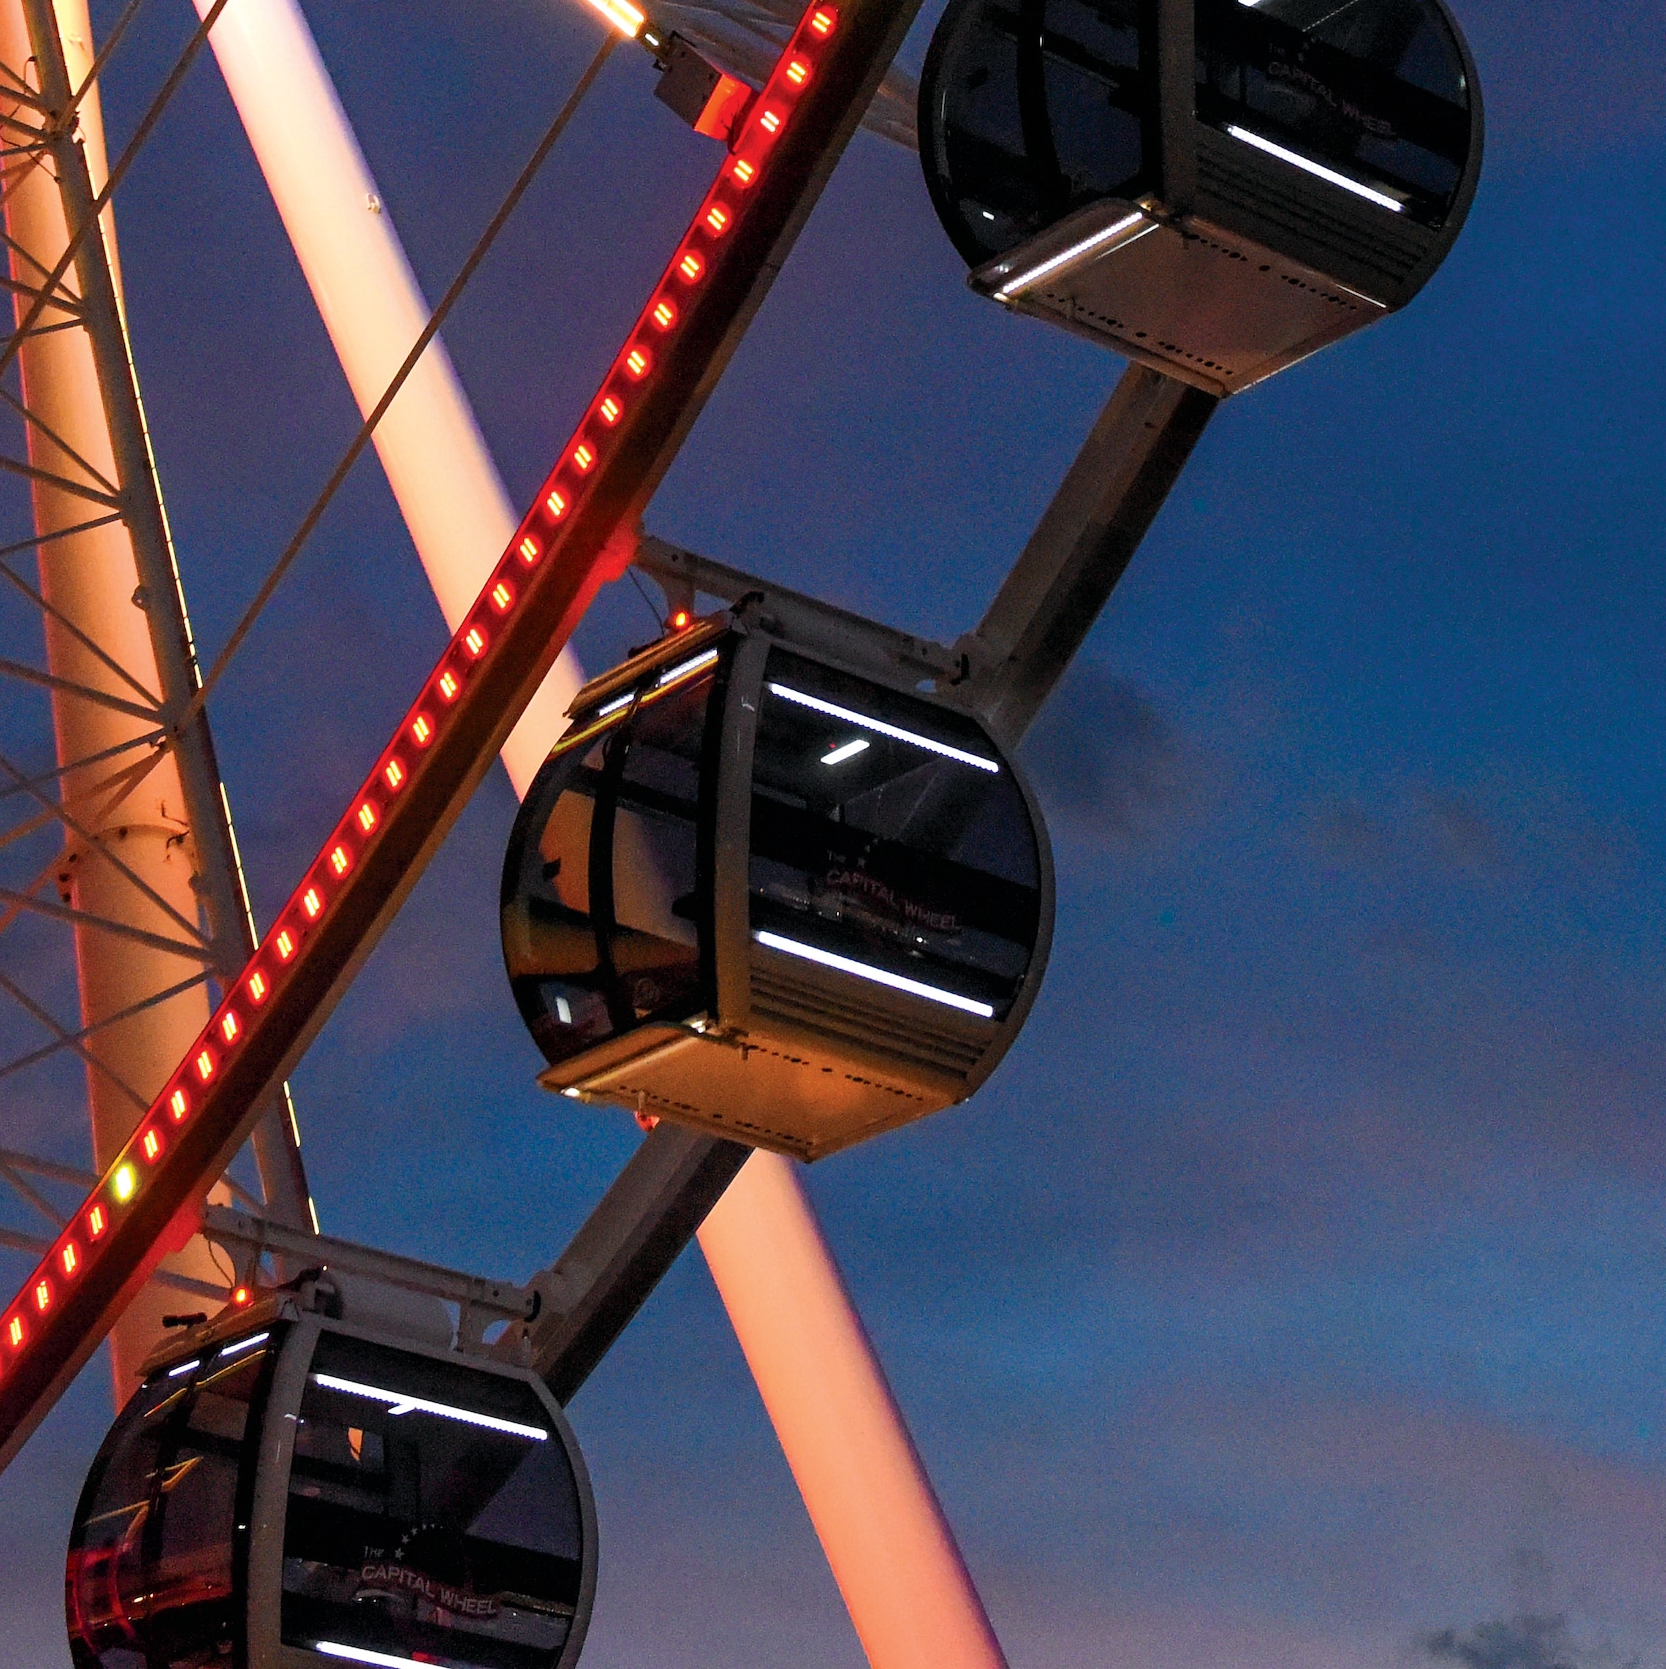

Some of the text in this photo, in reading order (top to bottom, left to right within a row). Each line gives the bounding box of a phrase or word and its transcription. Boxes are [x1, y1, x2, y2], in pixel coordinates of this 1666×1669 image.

[826, 869, 900, 910] CAPITAL
[361, 1565, 496, 1614] CAPITAL WHEEL
